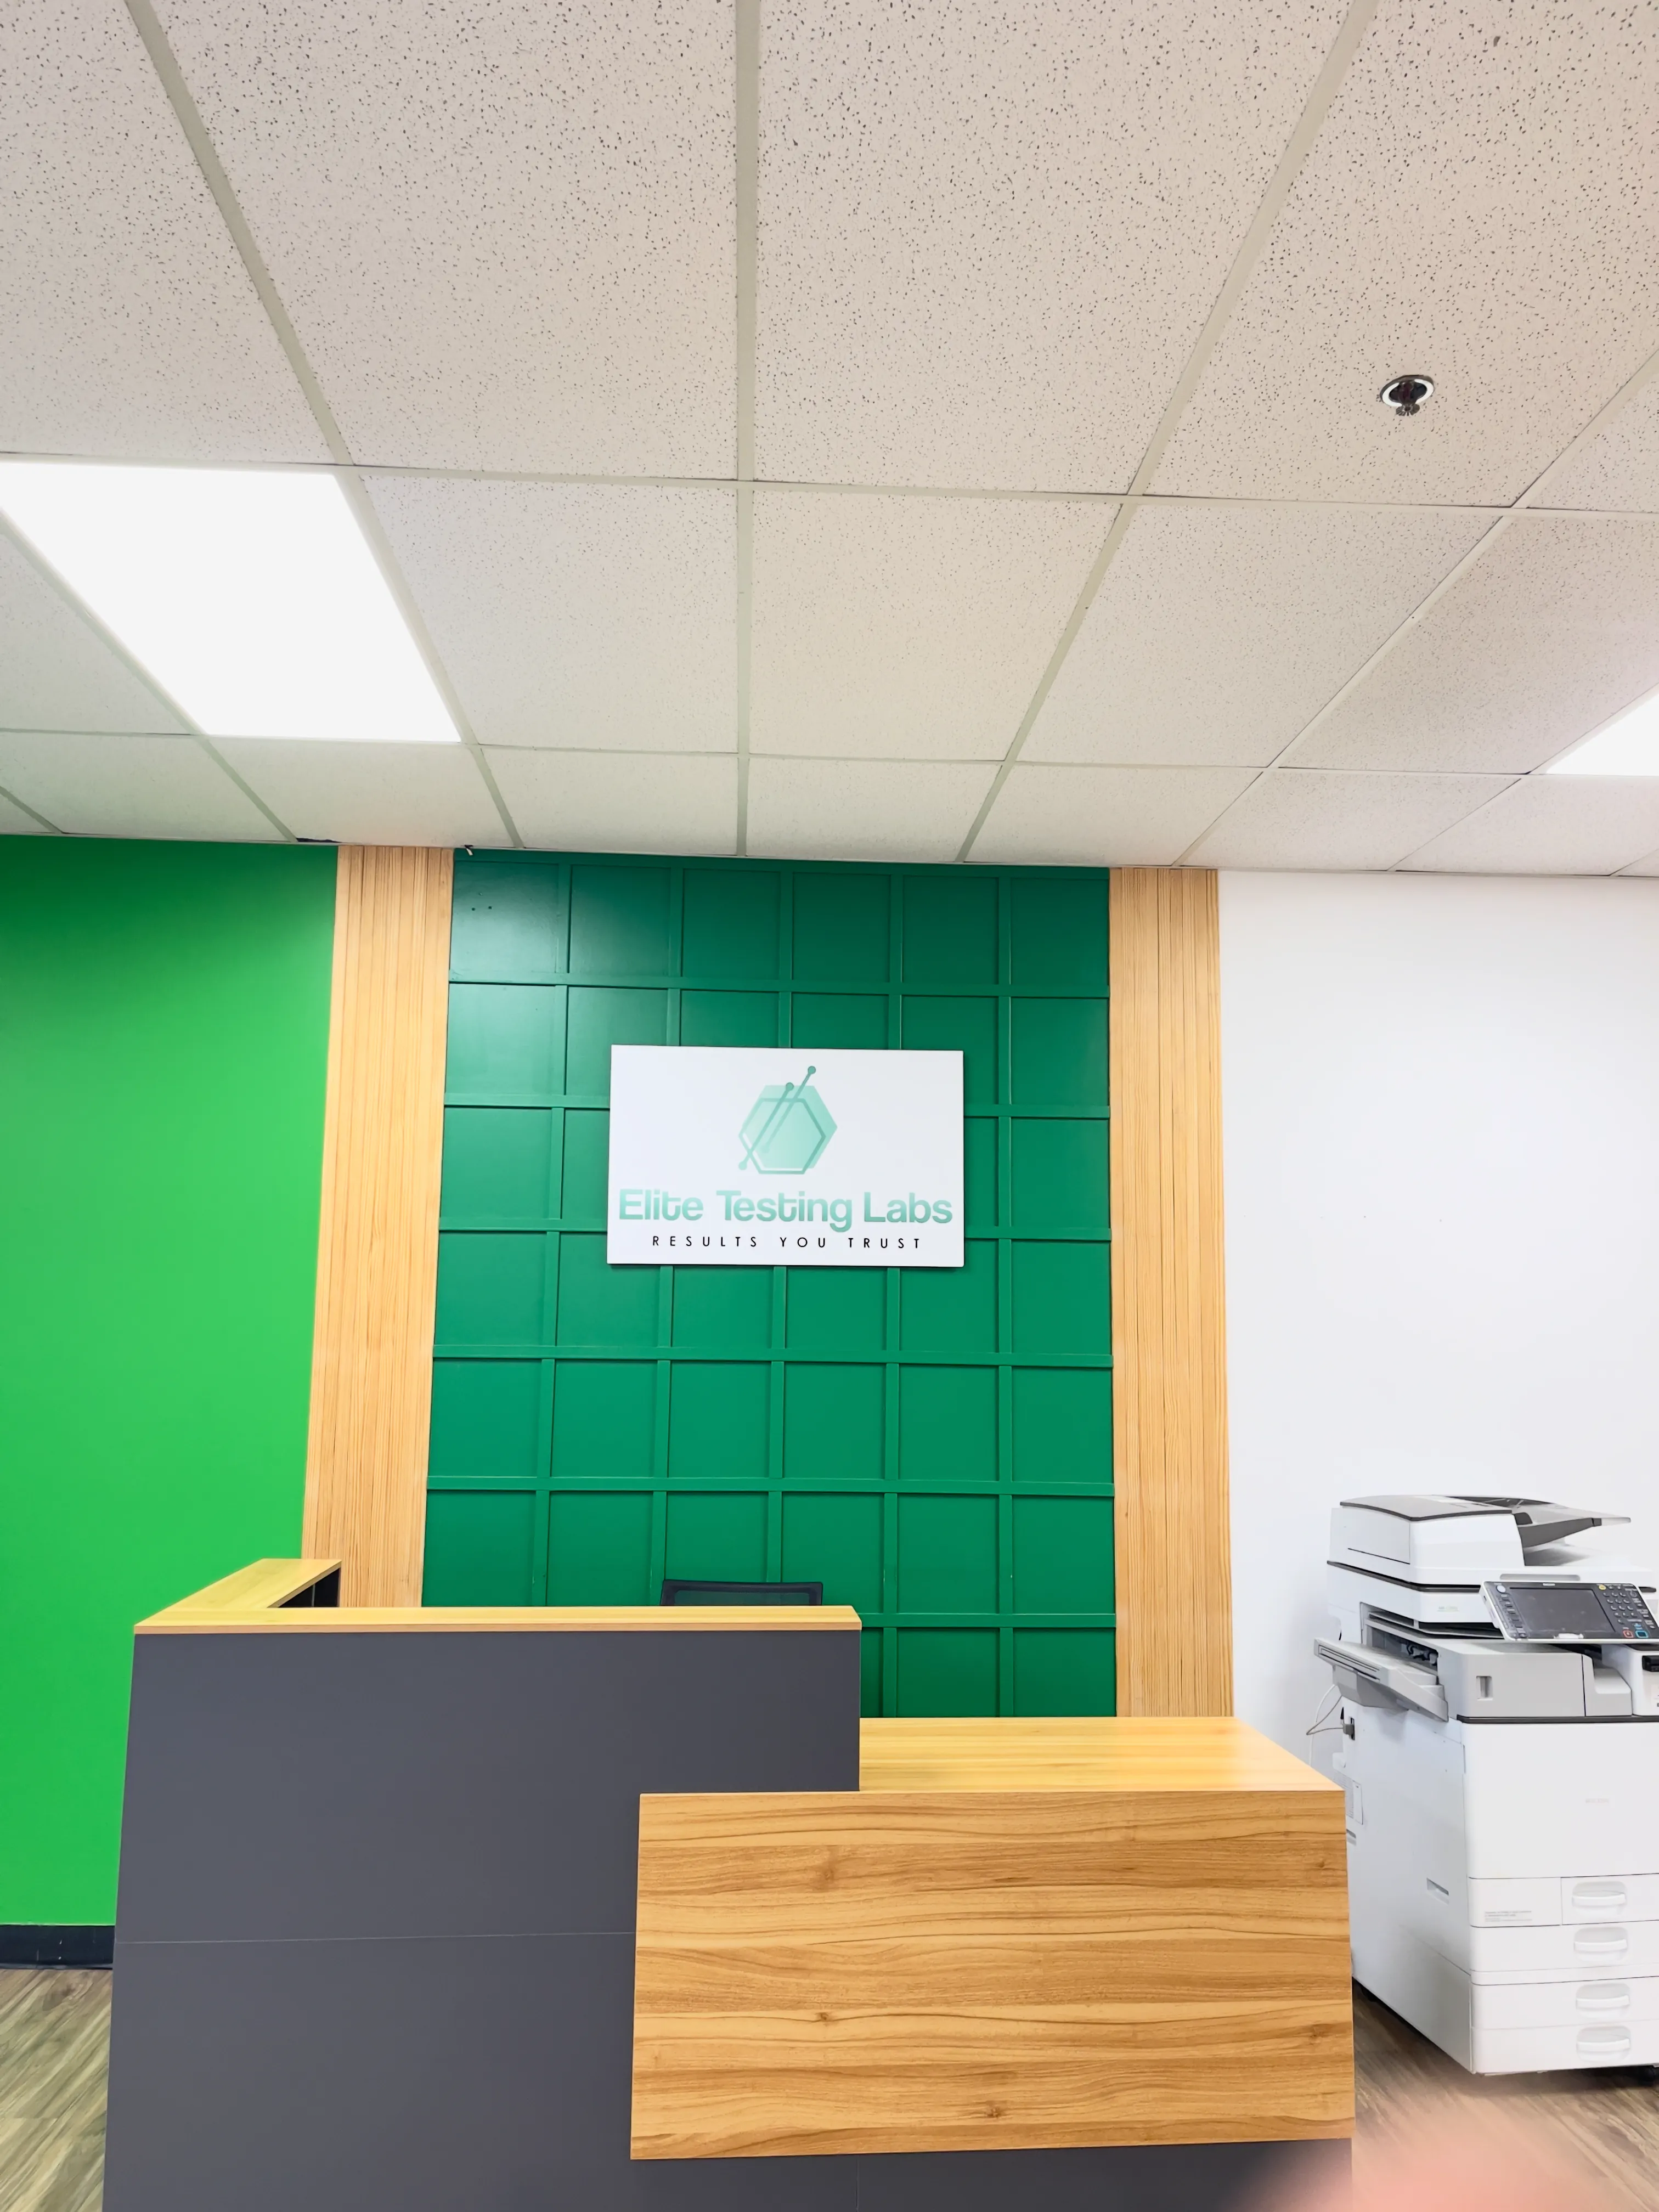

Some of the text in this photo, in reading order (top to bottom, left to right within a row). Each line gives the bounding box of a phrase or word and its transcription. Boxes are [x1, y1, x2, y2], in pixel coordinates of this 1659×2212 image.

[619, 1189, 953, 1233] Elite Testing Labs
[652, 1235, 920, 1249] RESULTS YOU TRUST
